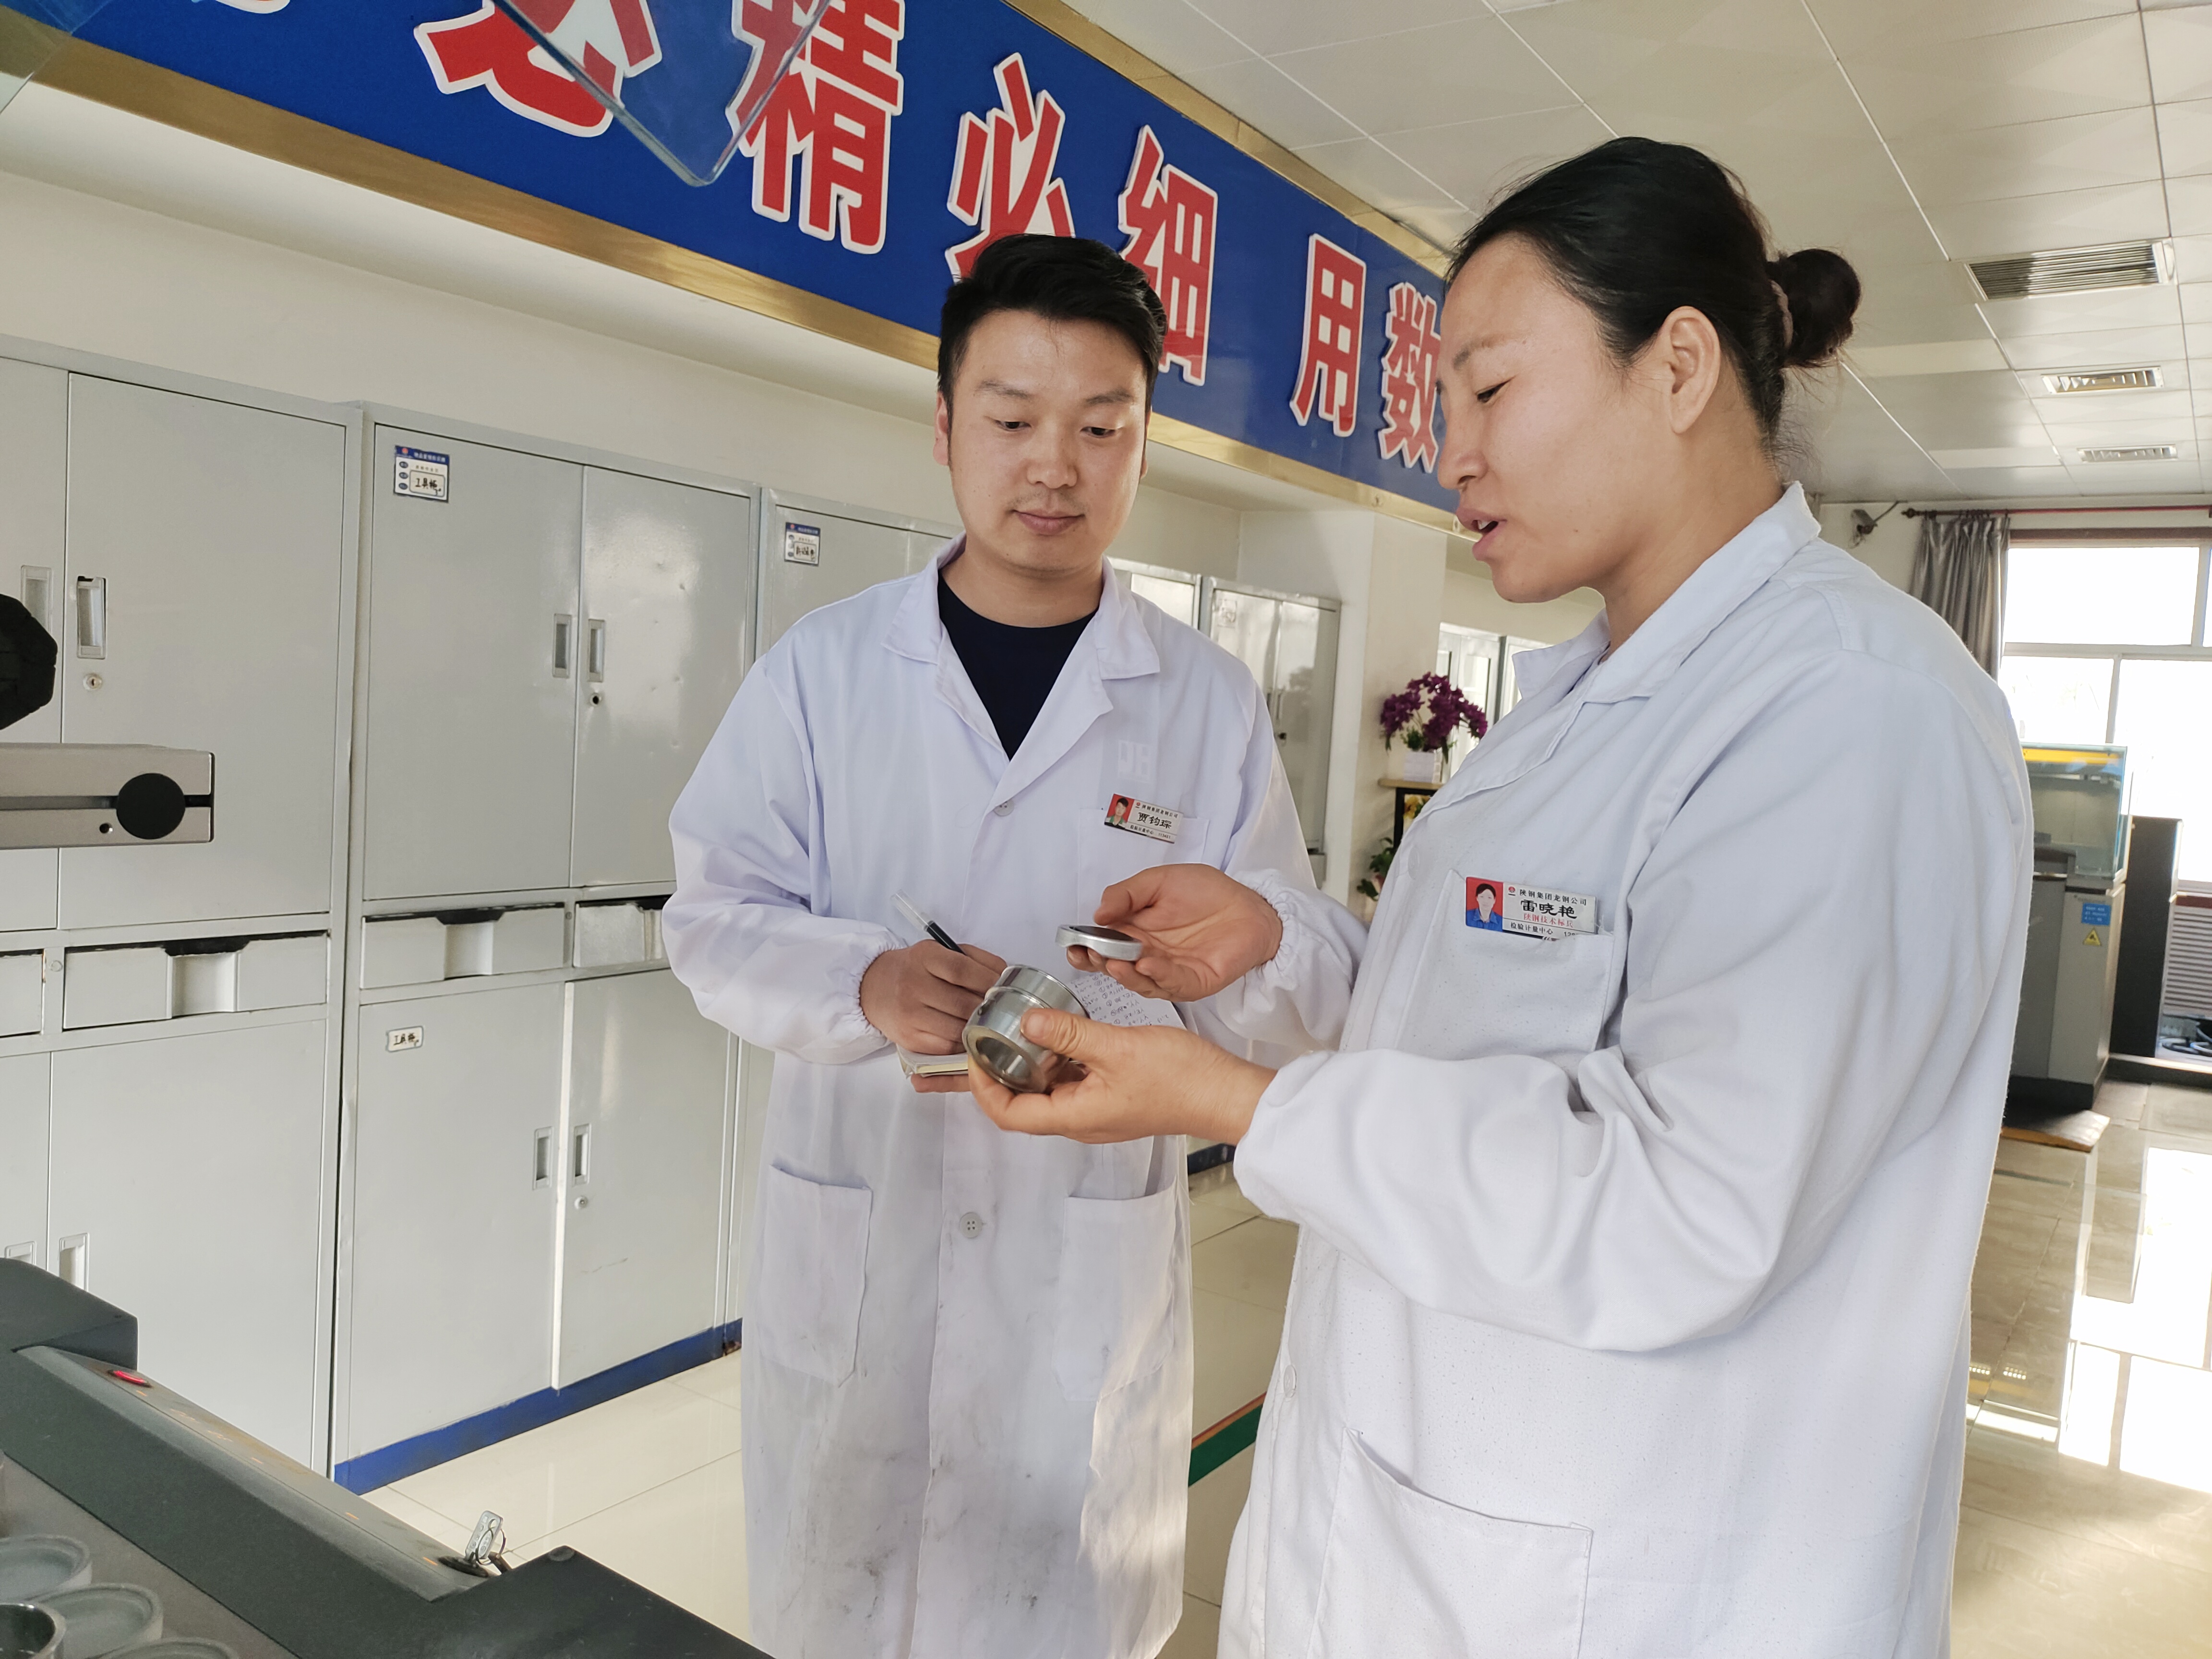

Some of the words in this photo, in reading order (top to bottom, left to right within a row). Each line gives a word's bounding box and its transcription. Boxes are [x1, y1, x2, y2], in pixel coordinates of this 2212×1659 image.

[1519, 889, 1587, 906] 陕钢集团龙钢公司
[1520, 899, 1578, 919] 雷晓艳
[1510, 922, 1553, 935] 检验计量中心
[1523, 913, 1574, 928] 陕钢技术标兵
